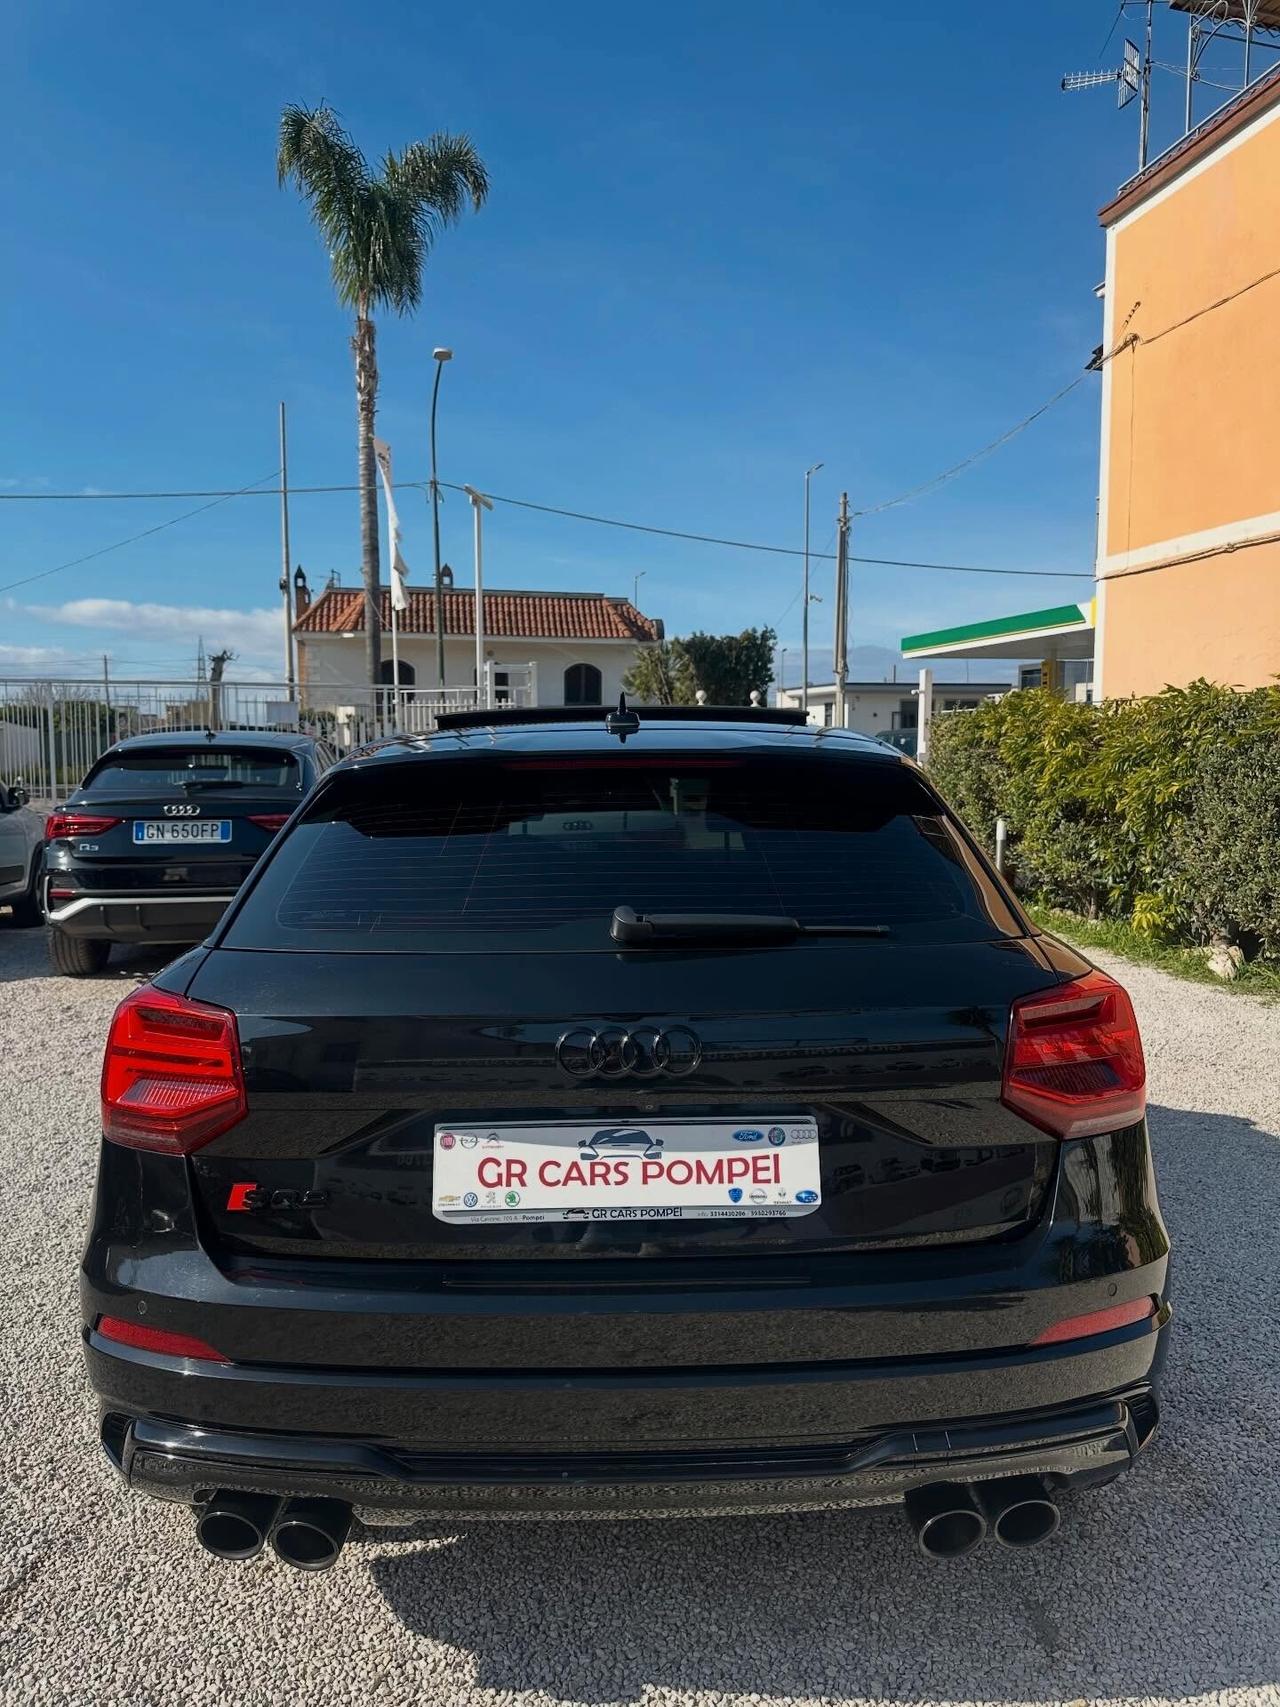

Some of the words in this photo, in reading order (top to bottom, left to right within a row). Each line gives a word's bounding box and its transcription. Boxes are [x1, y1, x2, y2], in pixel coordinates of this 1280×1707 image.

[478, 1157, 528, 1188] GR
[538, 1160, 630, 1187] CARS
[641, 1153, 781, 1186] POMPEI
[592, 1209, 608, 1219] GR
[610, 1209, 638, 1219] CARS
[640, 1207, 683, 1218] POMPEI
